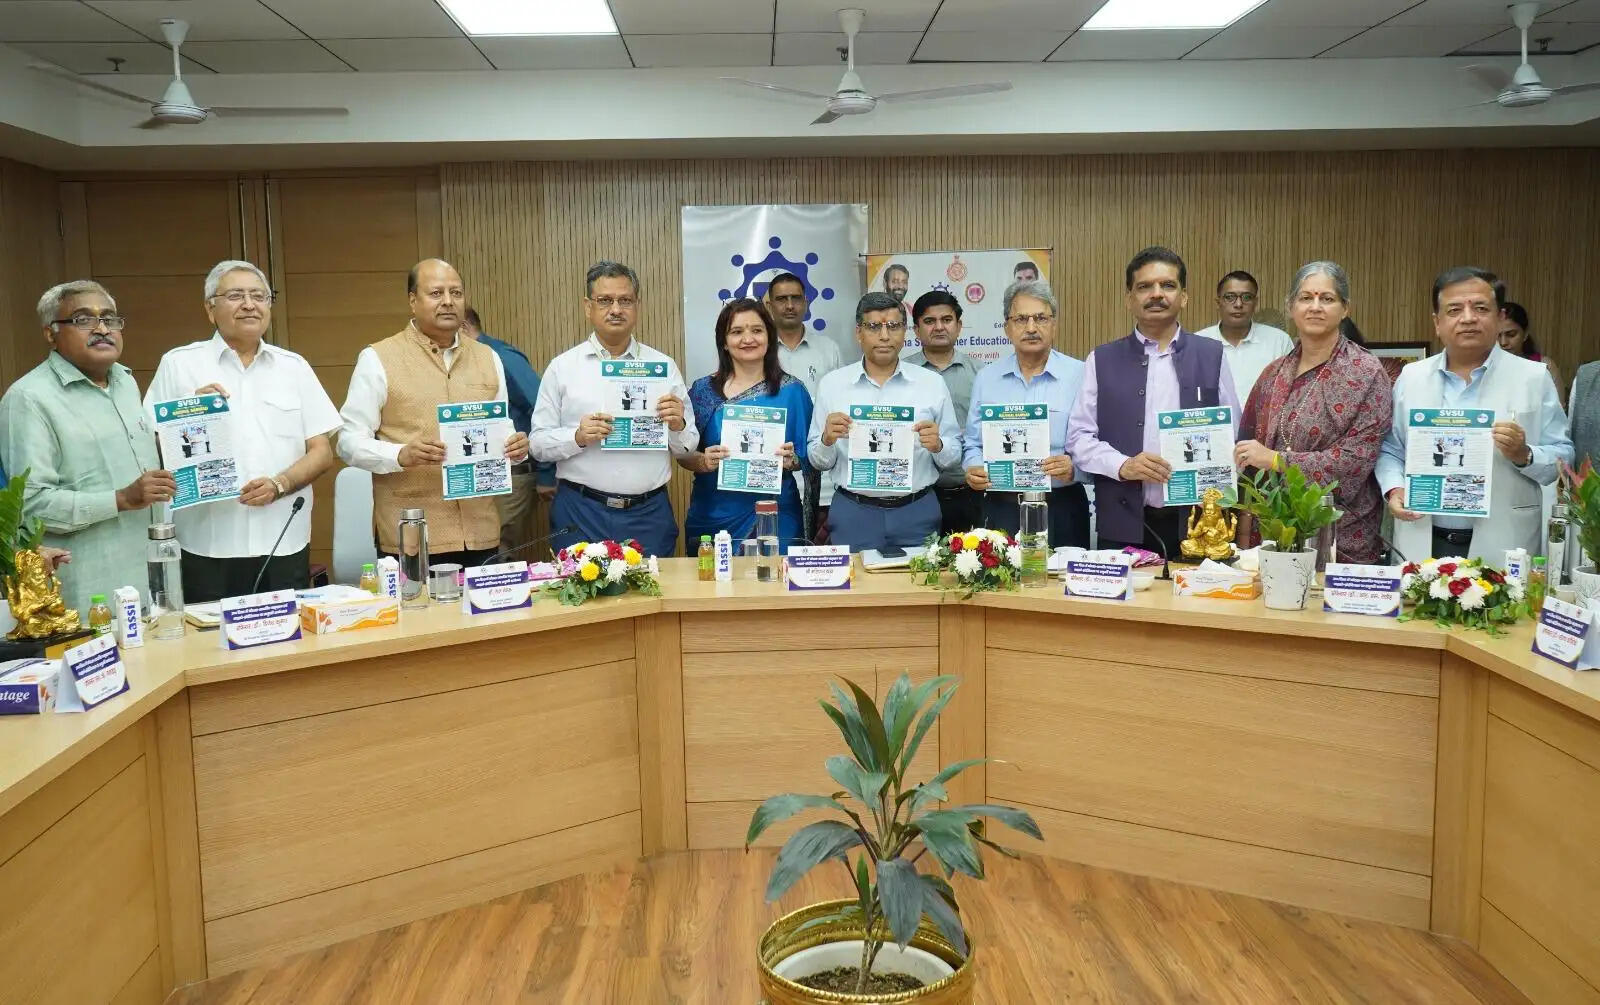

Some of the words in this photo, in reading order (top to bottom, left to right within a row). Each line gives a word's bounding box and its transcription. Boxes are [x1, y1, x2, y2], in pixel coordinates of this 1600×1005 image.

[970, 335, 1012, 346] Education
[984, 351, 1000, 359] with
[177, 397, 201, 408] SVSU
[462, 403, 483, 411] SVSU
[1183, 410, 1206, 418] SVSU
[1439, 409, 1464, 417] SVSU
[718, 543, 729, 573] Lassi
[1508, 563, 1520, 578] si
[386, 573, 398, 599] assi
[124, 604, 138, 639] Lassi
